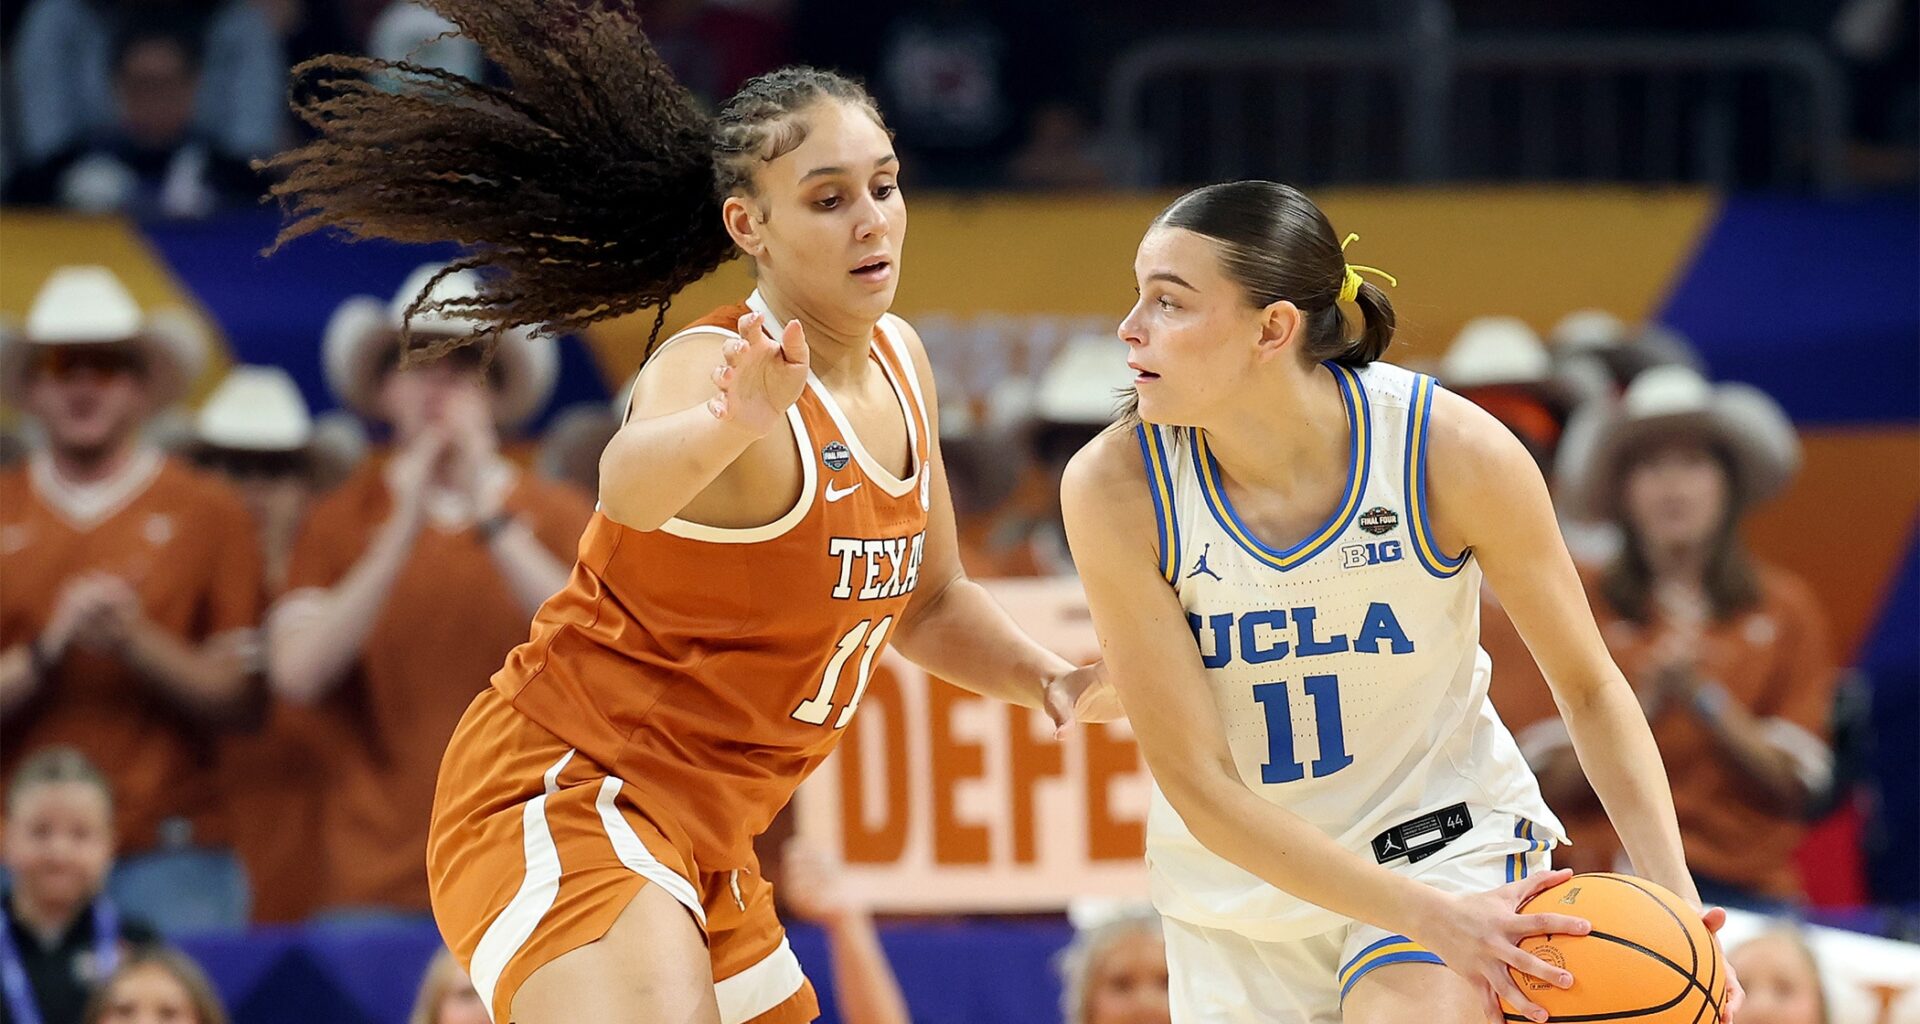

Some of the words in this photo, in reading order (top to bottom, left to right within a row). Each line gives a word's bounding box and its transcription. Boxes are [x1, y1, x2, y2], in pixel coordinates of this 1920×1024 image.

[1360, 517, 1378, 525] FINAL
[1379, 515, 1397, 524] FOUR
[1189, 602, 1415, 669] UCLA
[790, 615, 893, 729] 11
[1252, 674, 1354, 784] 11
[1446, 813, 1464, 829] 44
